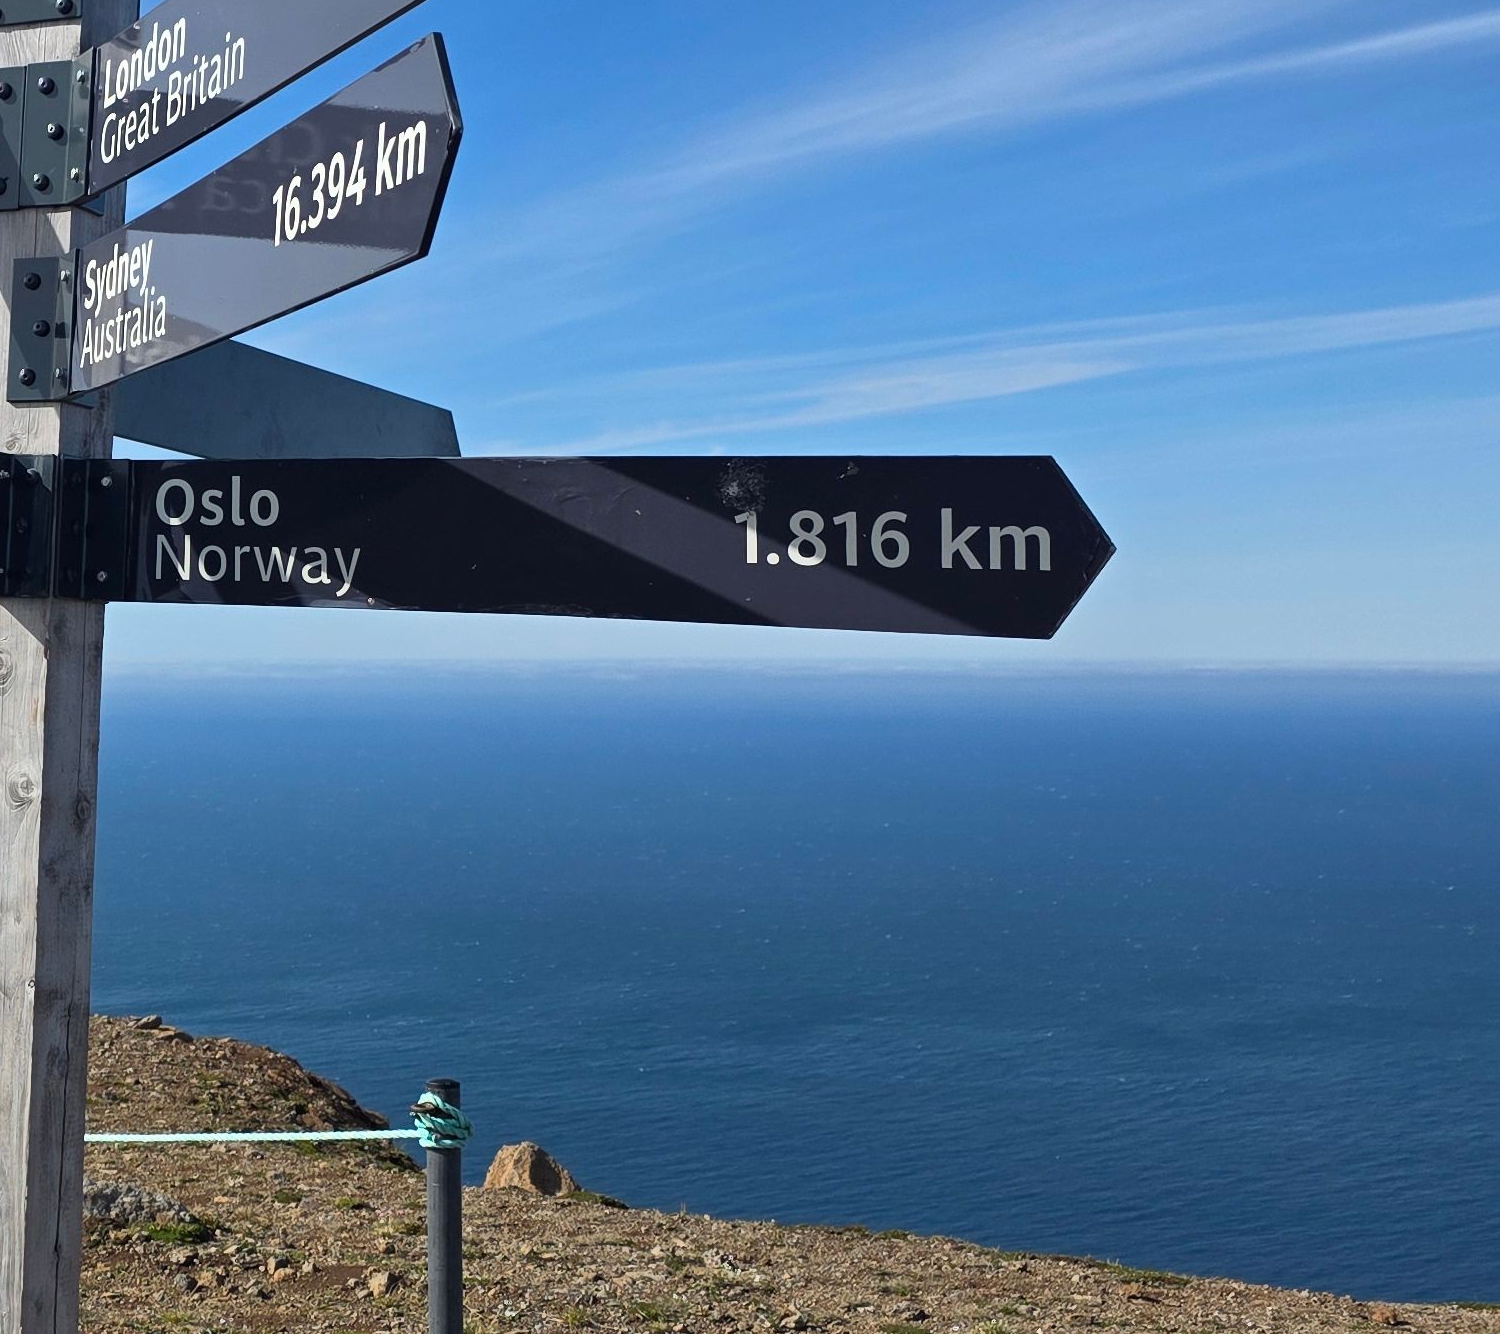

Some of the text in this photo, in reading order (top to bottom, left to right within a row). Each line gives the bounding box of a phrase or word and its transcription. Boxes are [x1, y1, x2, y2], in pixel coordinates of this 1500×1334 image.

[100, 31, 245, 164] Great Britain
[103, 17, 186, 109] London
[272, 138, 367, 247] 16.394
[375, 120, 427, 196] km
[83, 238, 153, 318] Sydney
[79, 286, 166, 369] Australia
[155, 475, 280, 527] Oslo
[734, 507, 1051, 571] 1.816 km
[154, 534, 361, 598] Norway
